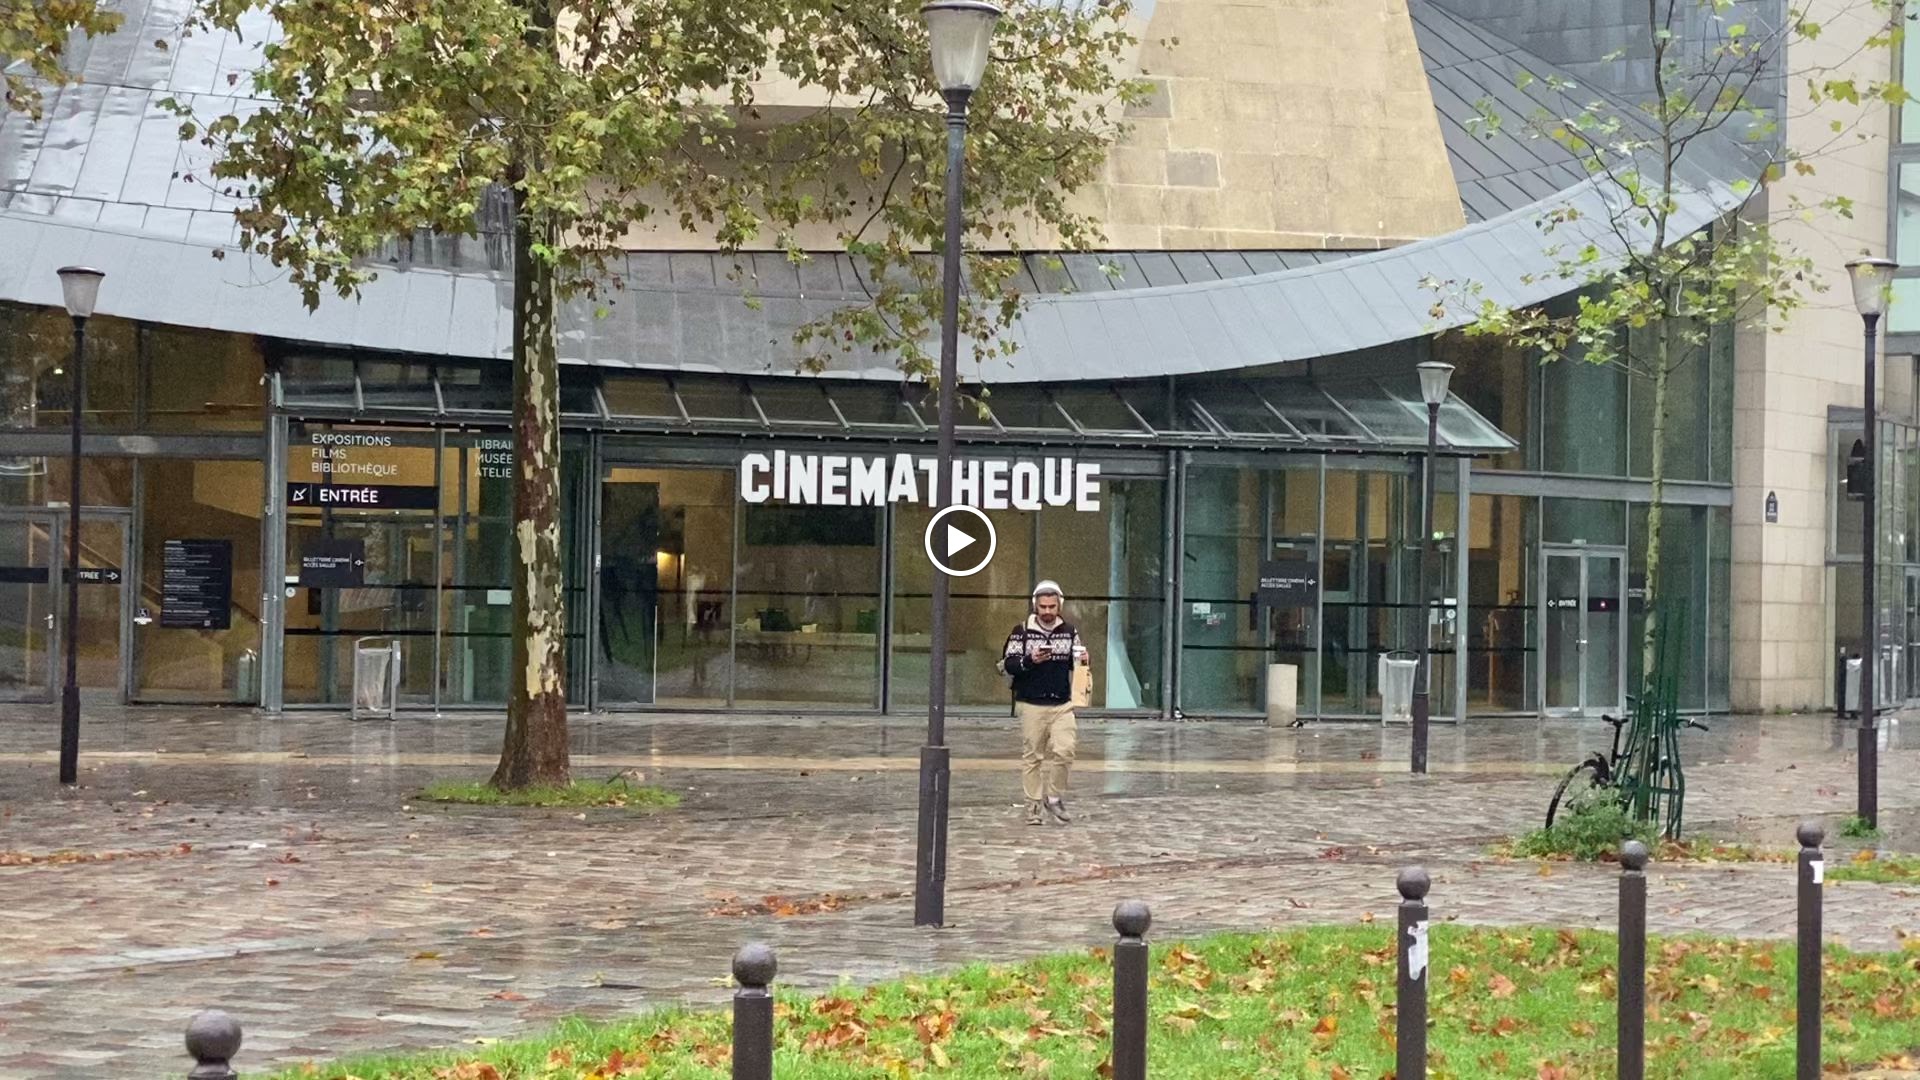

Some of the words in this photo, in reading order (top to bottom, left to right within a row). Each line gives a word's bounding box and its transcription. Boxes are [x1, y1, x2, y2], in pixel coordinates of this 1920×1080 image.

[311, 433, 392, 446] EXPOSITIONS
[475, 439, 513, 450] LIBRAI
[311, 447, 347, 459] FILMS
[475, 452, 513, 464] MUSÉE
[311, 461, 398, 476] BIBLIOTHÈQUE
[475, 466, 512, 478] ATELIE
[741, 450, 1100, 512] CINEMATHEQUE
[319, 487, 378, 503] ENTRÉE
